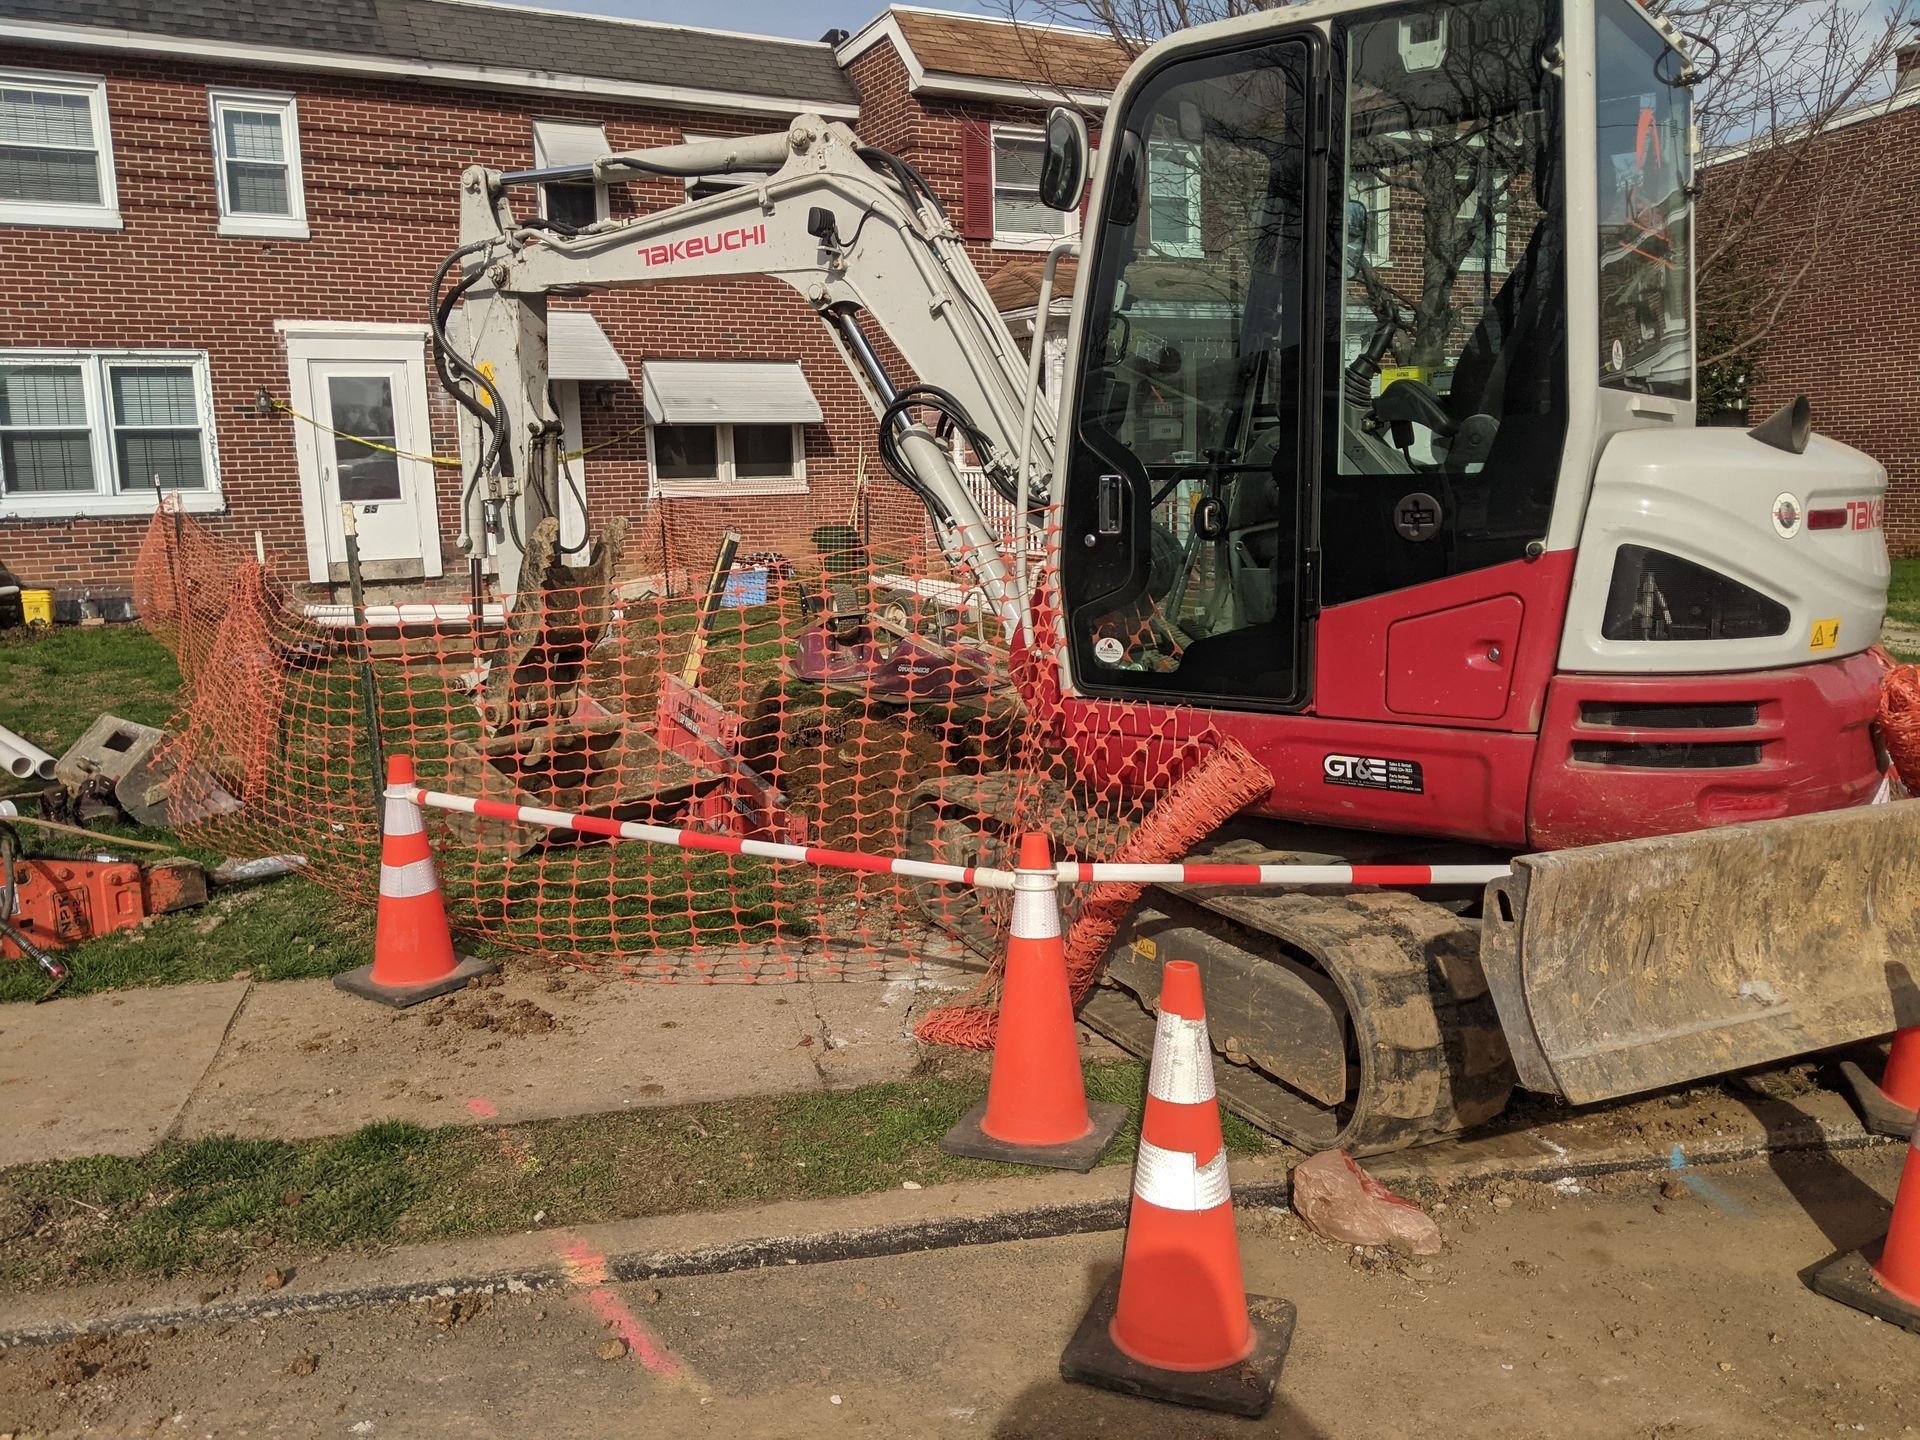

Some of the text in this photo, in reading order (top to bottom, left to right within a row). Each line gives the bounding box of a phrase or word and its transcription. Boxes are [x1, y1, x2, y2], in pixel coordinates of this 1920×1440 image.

[638, 224, 766, 267] TAKEUCHI
[363, 504, 379, 514] 65
[1324, 755, 1387, 782] GT&E
